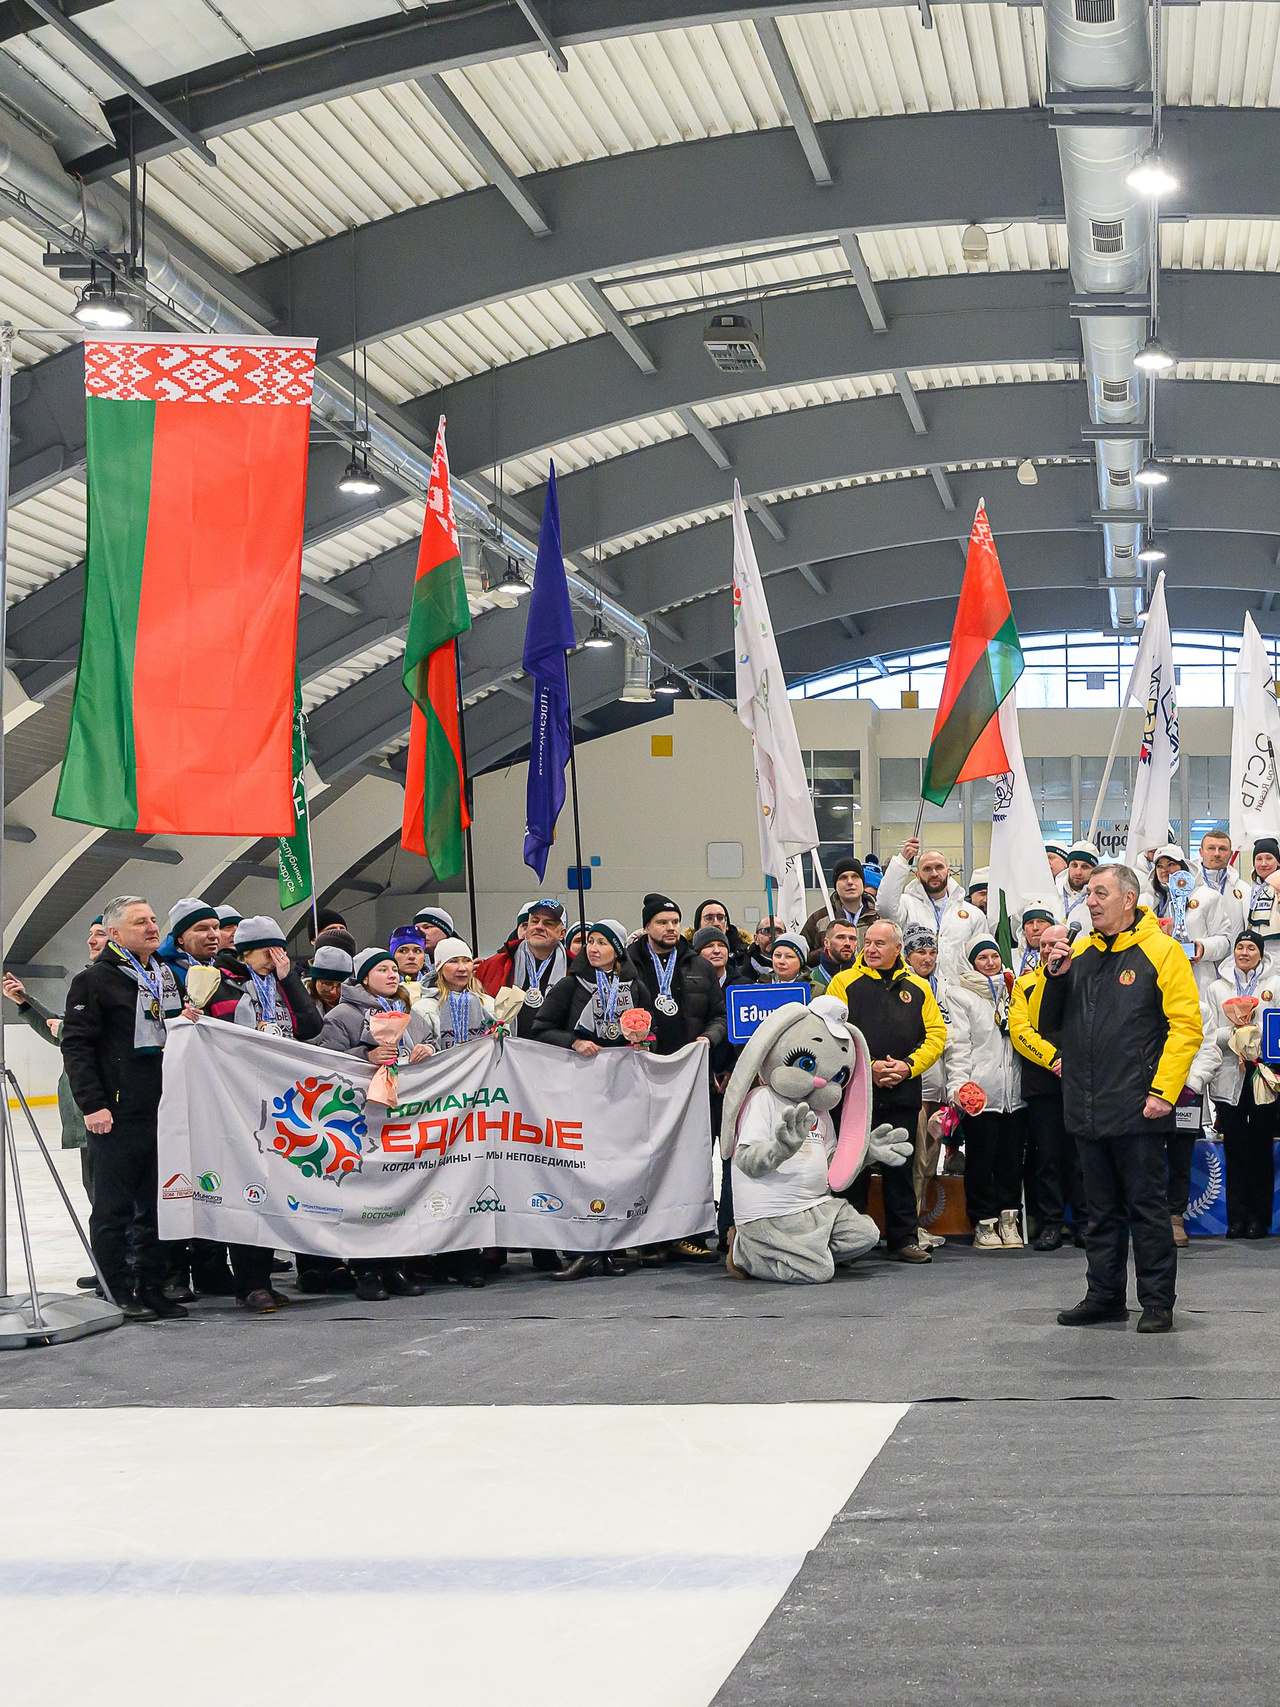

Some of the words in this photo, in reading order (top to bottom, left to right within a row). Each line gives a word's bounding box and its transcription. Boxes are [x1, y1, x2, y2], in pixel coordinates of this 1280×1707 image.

[1018, 1034, 1044, 1060] BELARUS
[386, 1087, 510, 1118] КОМАНДА
[380, 1111, 584, 1159] ЕДИНЫЕ
[381, 1161, 416, 1173] КОГДА
[418, 1160, 437, 1170] МЫ
[486, 1151, 503, 1160] МЫ
[506, 1153, 587, 1170] НЕПОБЕДИМЫ!
[361, 1208, 407, 1219] ВОСТОЧНЫЙ
